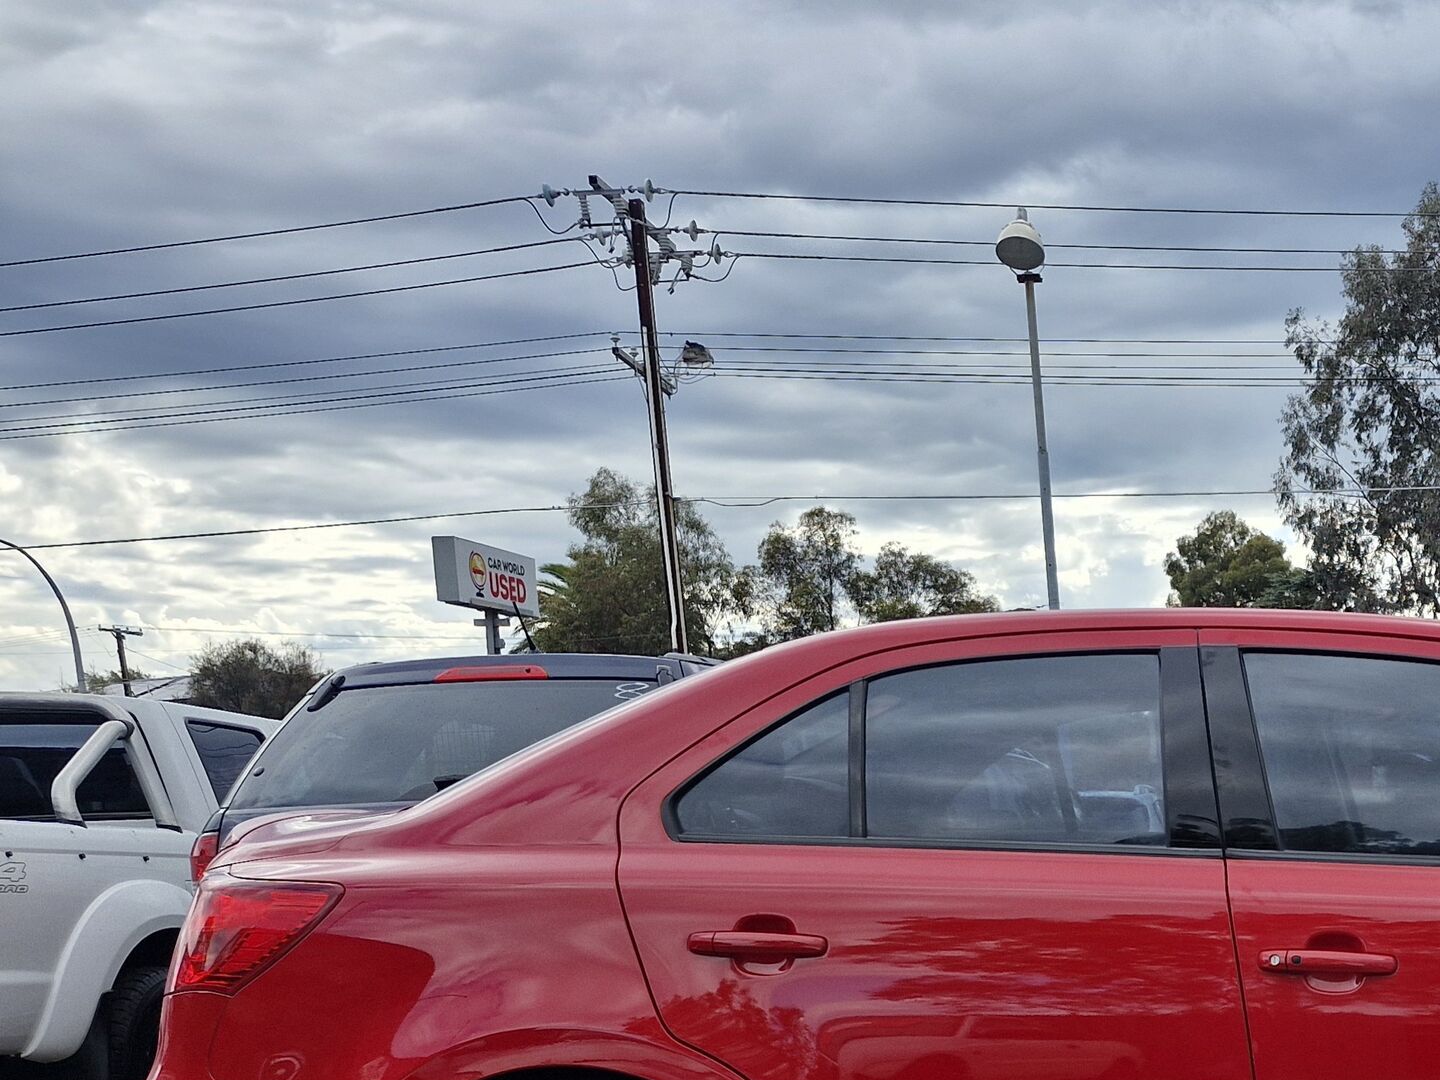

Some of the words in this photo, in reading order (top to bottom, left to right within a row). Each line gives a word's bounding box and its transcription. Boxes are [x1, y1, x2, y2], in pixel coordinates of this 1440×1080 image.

[488, 557, 502, 571] CAR
[502, 560, 526, 576] WORLD
[488, 571, 527, 604] USED
